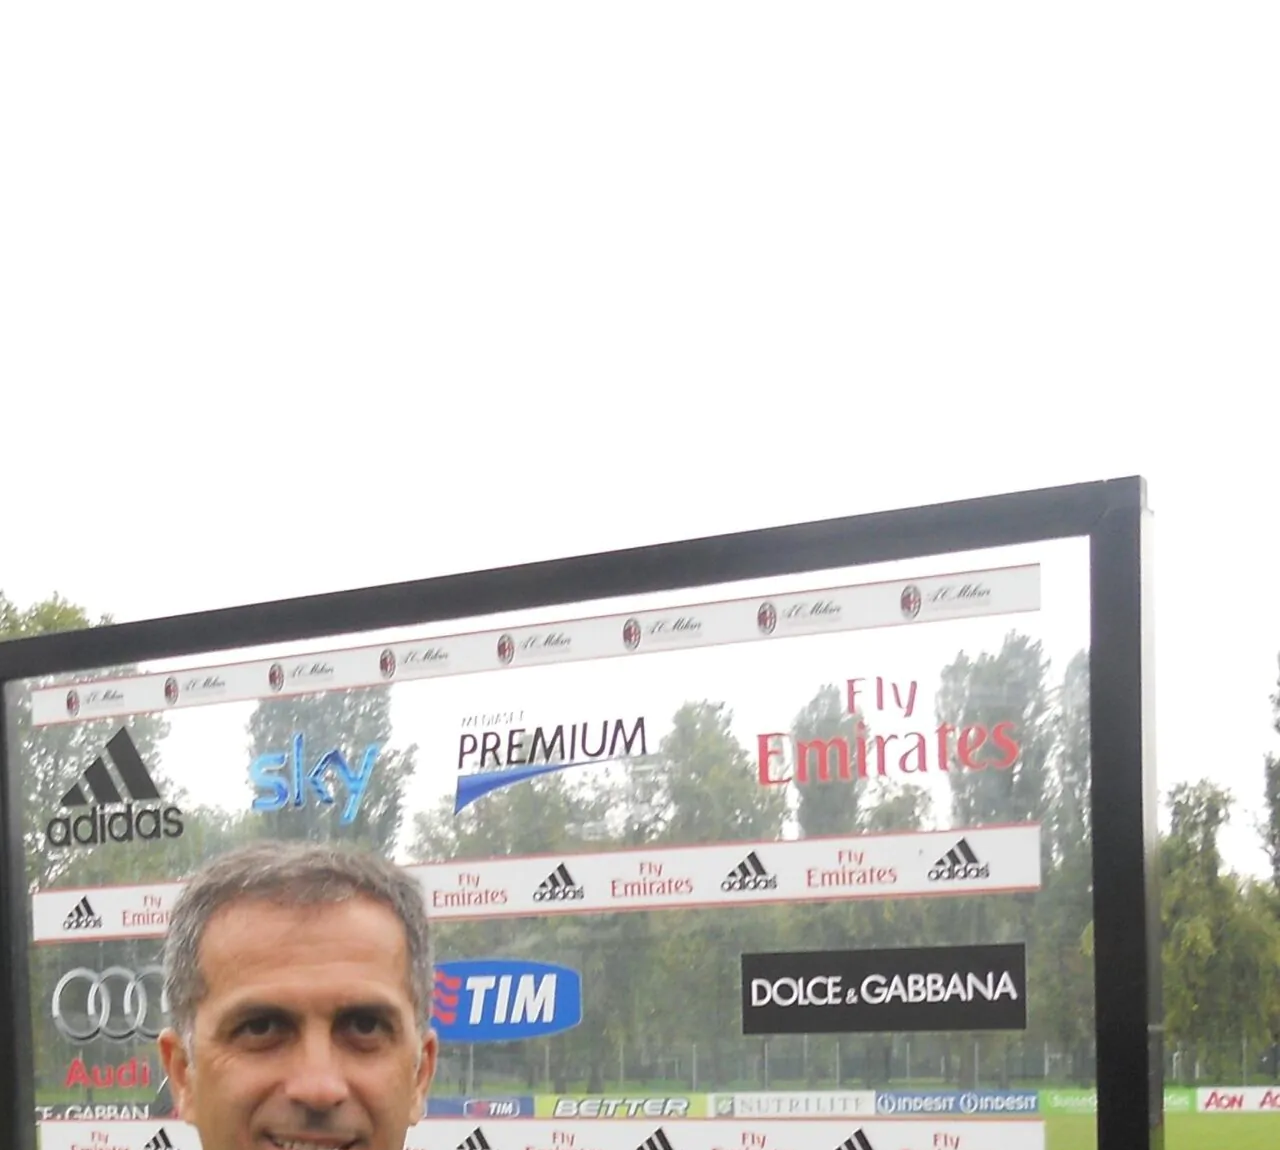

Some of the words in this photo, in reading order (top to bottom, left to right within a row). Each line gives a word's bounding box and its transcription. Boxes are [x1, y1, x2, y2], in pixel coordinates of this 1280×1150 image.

[846, 677, 918, 718] Fly
[458, 716, 648, 770] PREMIUM
[756, 720, 1020, 787] Emirates
[250, 733, 380, 825] sky
[46, 802, 184, 847] adidas
[838, 850, 864, 866] Fly
[639, 862, 662, 877] Fly
[806, 865, 897, 888] Emirates
[927, 862, 989, 881] adidas
[458, 873, 481, 888] Fly
[611, 876, 693, 898] Emirates
[721, 874, 777, 892] adidas
[432, 889, 508, 908] Emirates
[532, 885, 585, 902] adidas
[122, 909, 170, 927] Emirat
[751, 975, 842, 1006] DOLCE
[845, 987, 859, 1005] &
[860, 970, 1019, 1004] GABBANA
[465, 973, 557, 1024] TIM
[64, 1057, 151, 1088] Audi
[489, 1101, 513, 1115] TIM
[552, 1098, 691, 1118] BETTER
[739, 1092, 864, 1114] NUTRILITE
[552, 1131, 575, 1147] Fly
[741, 1132, 766, 1149] Fly
[933, 1133, 960, 1150] Fly
